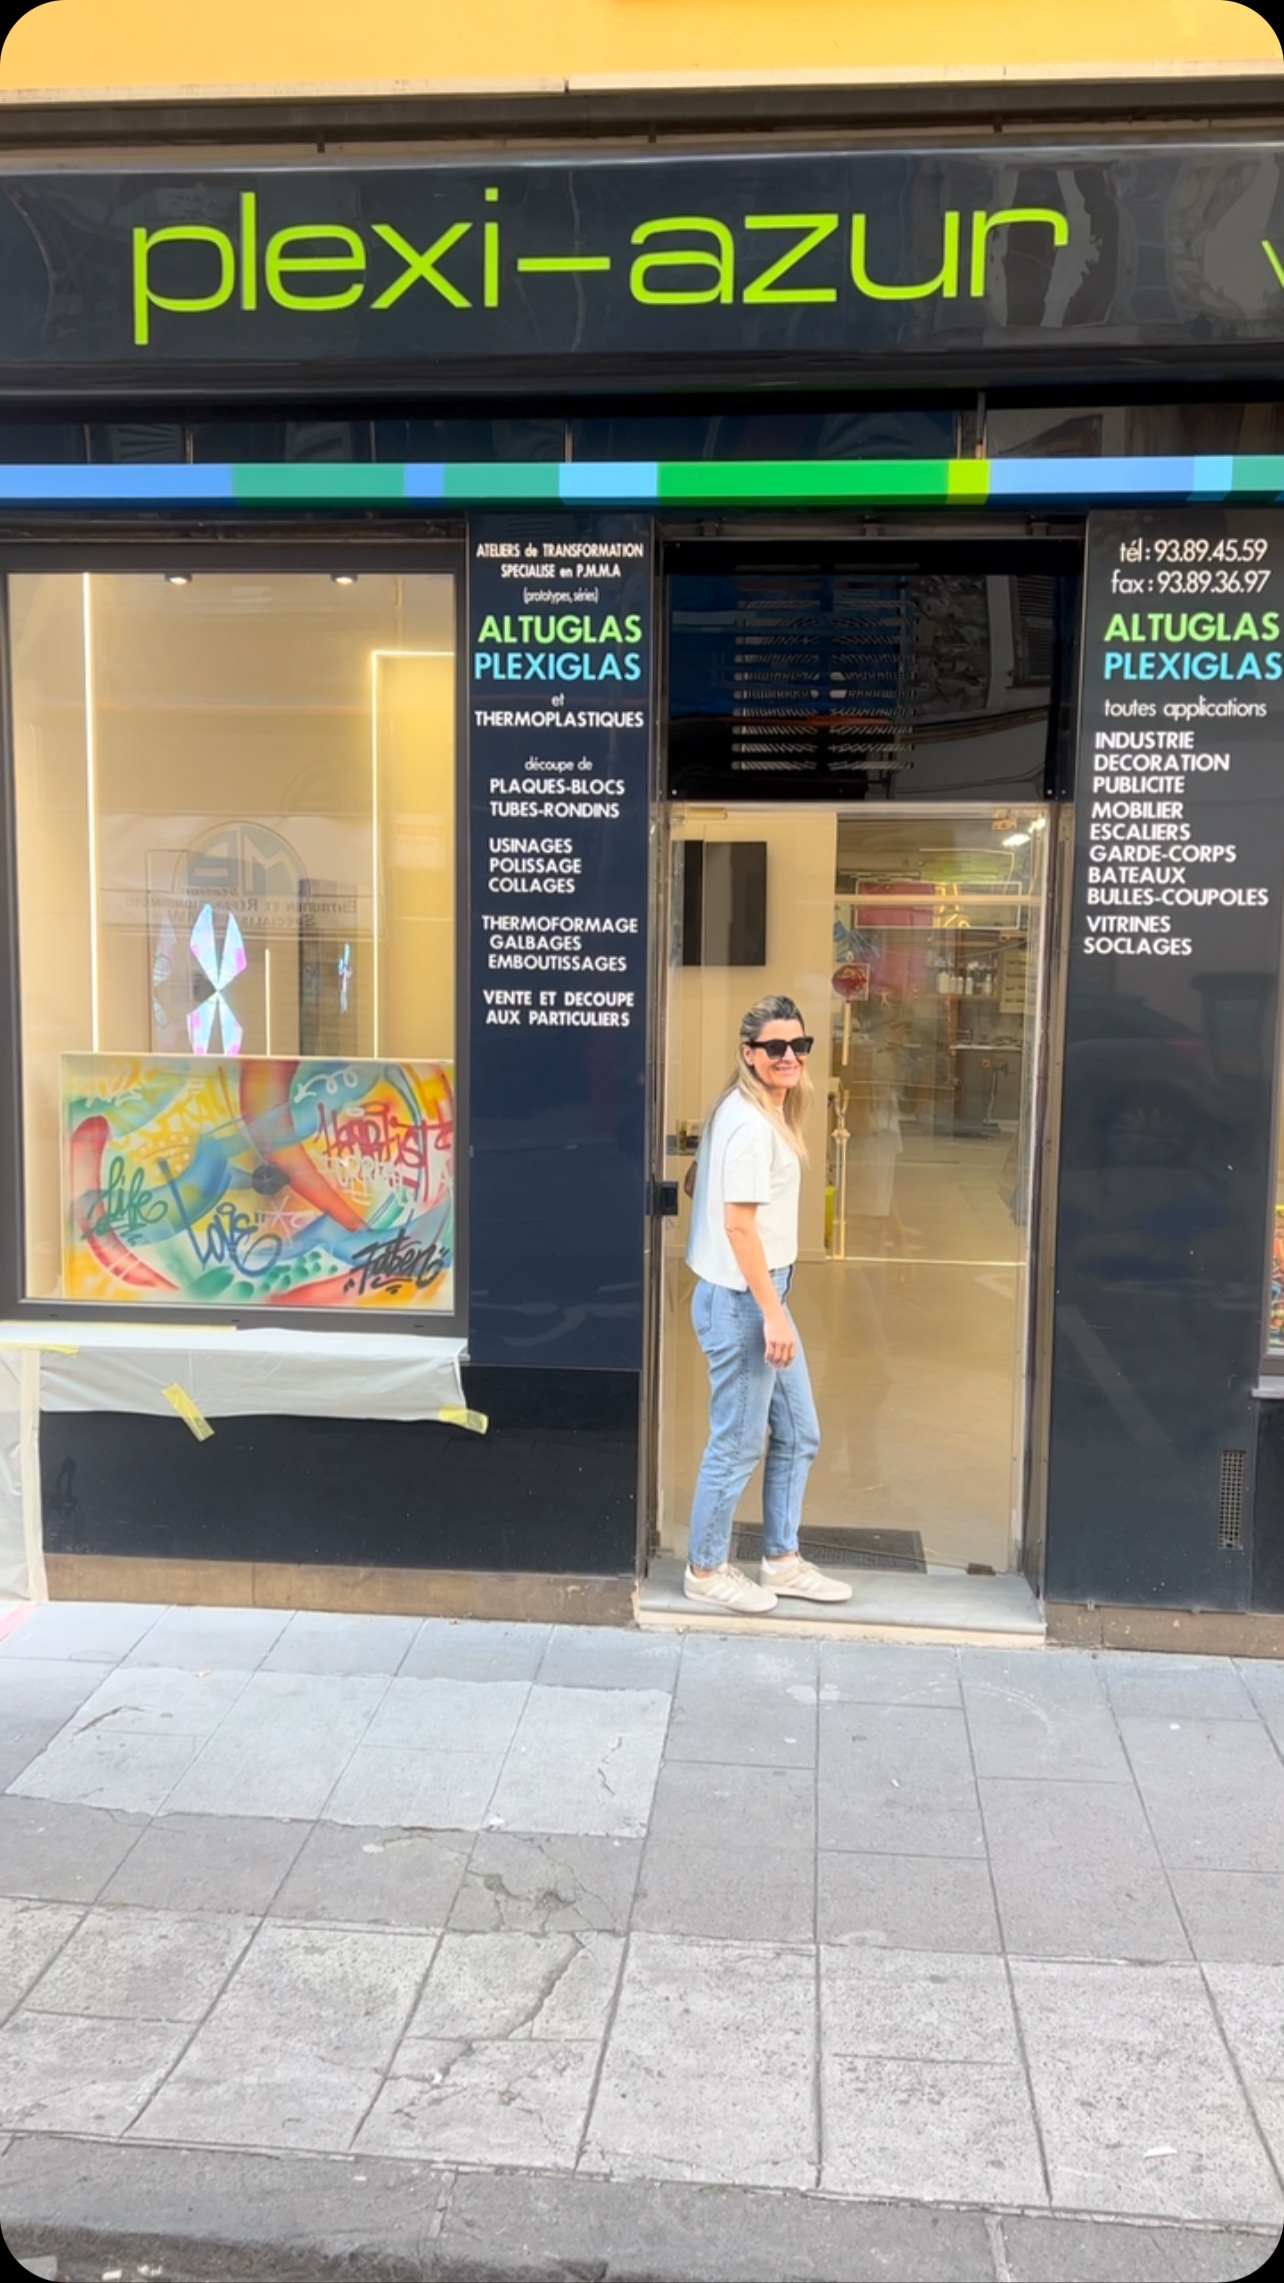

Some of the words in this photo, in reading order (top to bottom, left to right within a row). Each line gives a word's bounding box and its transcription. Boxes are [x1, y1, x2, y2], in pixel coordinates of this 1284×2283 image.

[476, 544, 521, 557] ATELIERS
[524, 543, 539, 557] de
[542, 543, 644, 557] TRANSFORMATION
[1153, 539, 1269, 562] 93.89.45.59
[500, 564, 555, 578] SPECIALISE
[559, 568, 573, 578] en
[1156, 570, 1271, 593] 93.89.36.97
[477, 615, 643, 643] ALTUGLAS
[1103, 612, 1280, 642] ALTUGLAS
[474, 653, 641, 680] PLEXIGLAS
[1104, 652, 1283, 680] PLEXIGLAS
[551, 693, 565, 706] et
[1104, 700, 1157, 716] toutes
[1162, 695, 1267, 721] applications
[474, 711, 645, 727] THERMOPLASTIQUES
[1094, 731, 1194, 749] INDUSTRIE
[524, 757, 575, 772] découpe
[577, 757, 593, 770] de
[1093, 754, 1230, 771] DECORATION
[489, 778, 625, 795] PLAQUES-BLOCS
[1092, 776, 1185, 793] PUBLICITE
[489, 801, 620, 818] TUBES-RONDINS
[1091, 801, 1184, 819] MOBILIER
[1089, 823, 1191, 841] ESCALIERS
[489, 838, 573, 853] USINAGES
[1089, 845, 1237, 862] GARDE-CORPS
[489, 858, 582, 873] POLISSAGE
[1088, 867, 1186, 884] BATEAUX
[488, 877, 576, 893] COLLAGES
[1087, 888, 1269, 906] BULLES-COUPOLES
[481, 915, 638, 933] THERMOFORMAGE
[1086, 916, 1171, 933] VITRINES
[489, 935, 582, 950] GALBAGES
[1083, 937, 1193, 955] SOCLAGES
[488, 954, 627, 971] EMBOUTISSAGES
[482, 990, 532, 1005] VENTE
[539, 991, 557, 1005] ET
[564, 992, 635, 1006] DECOUPE
[485, 1010, 521, 1024] AUX
[528, 1011, 630, 1026] PARTICULIERS
